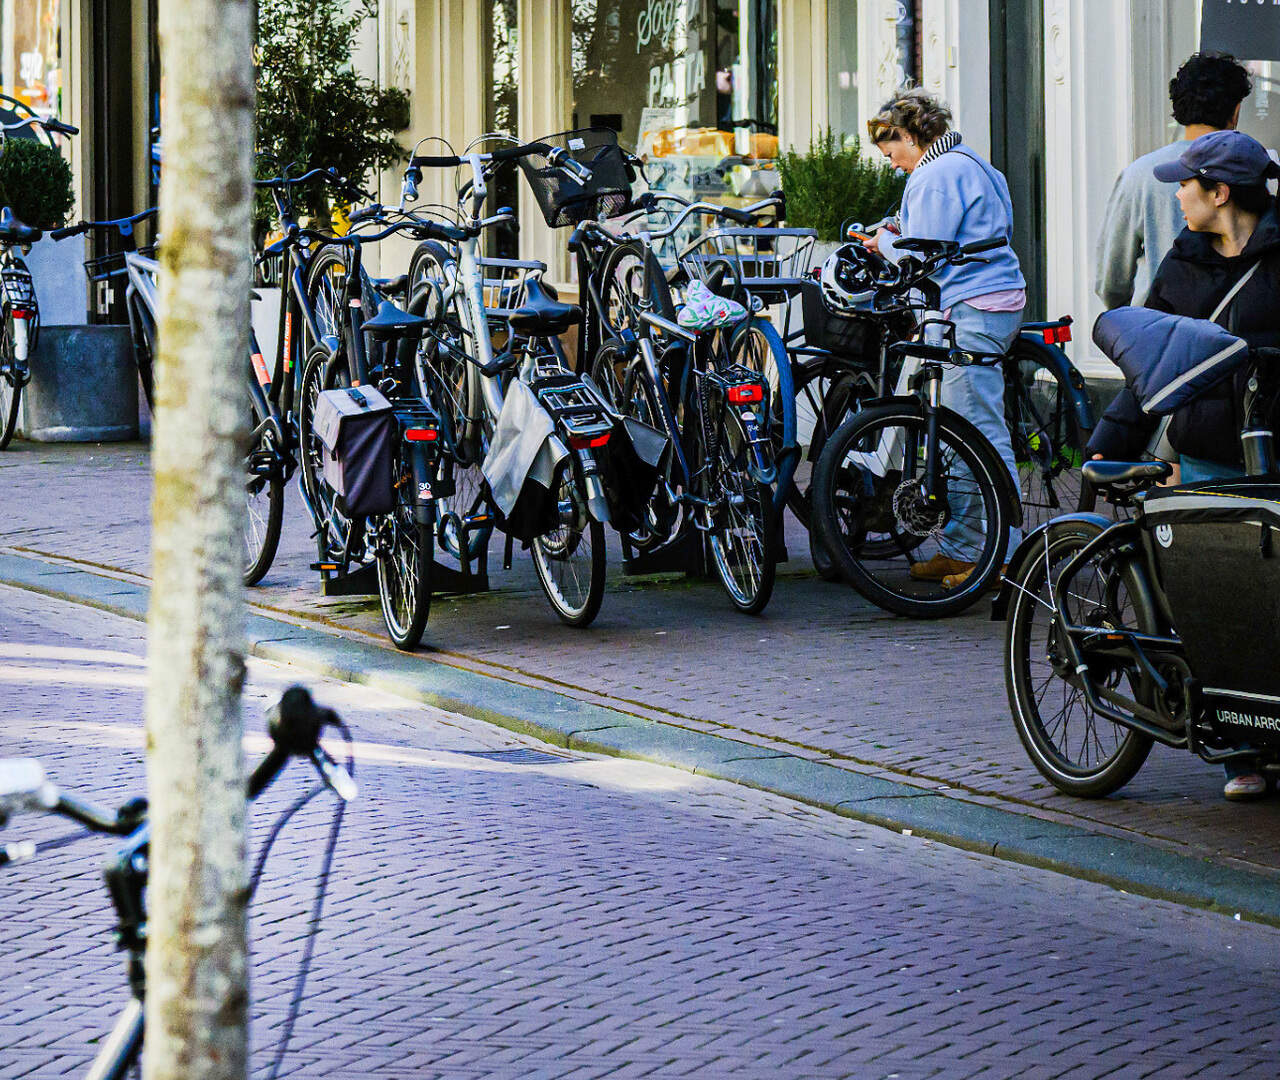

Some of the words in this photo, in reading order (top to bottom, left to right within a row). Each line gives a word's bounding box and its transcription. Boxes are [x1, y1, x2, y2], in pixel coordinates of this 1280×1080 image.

[649, 50, 706, 109] PATA
[418, 482, 431, 491] 30
[1216, 709, 1252, 726] URBAN
